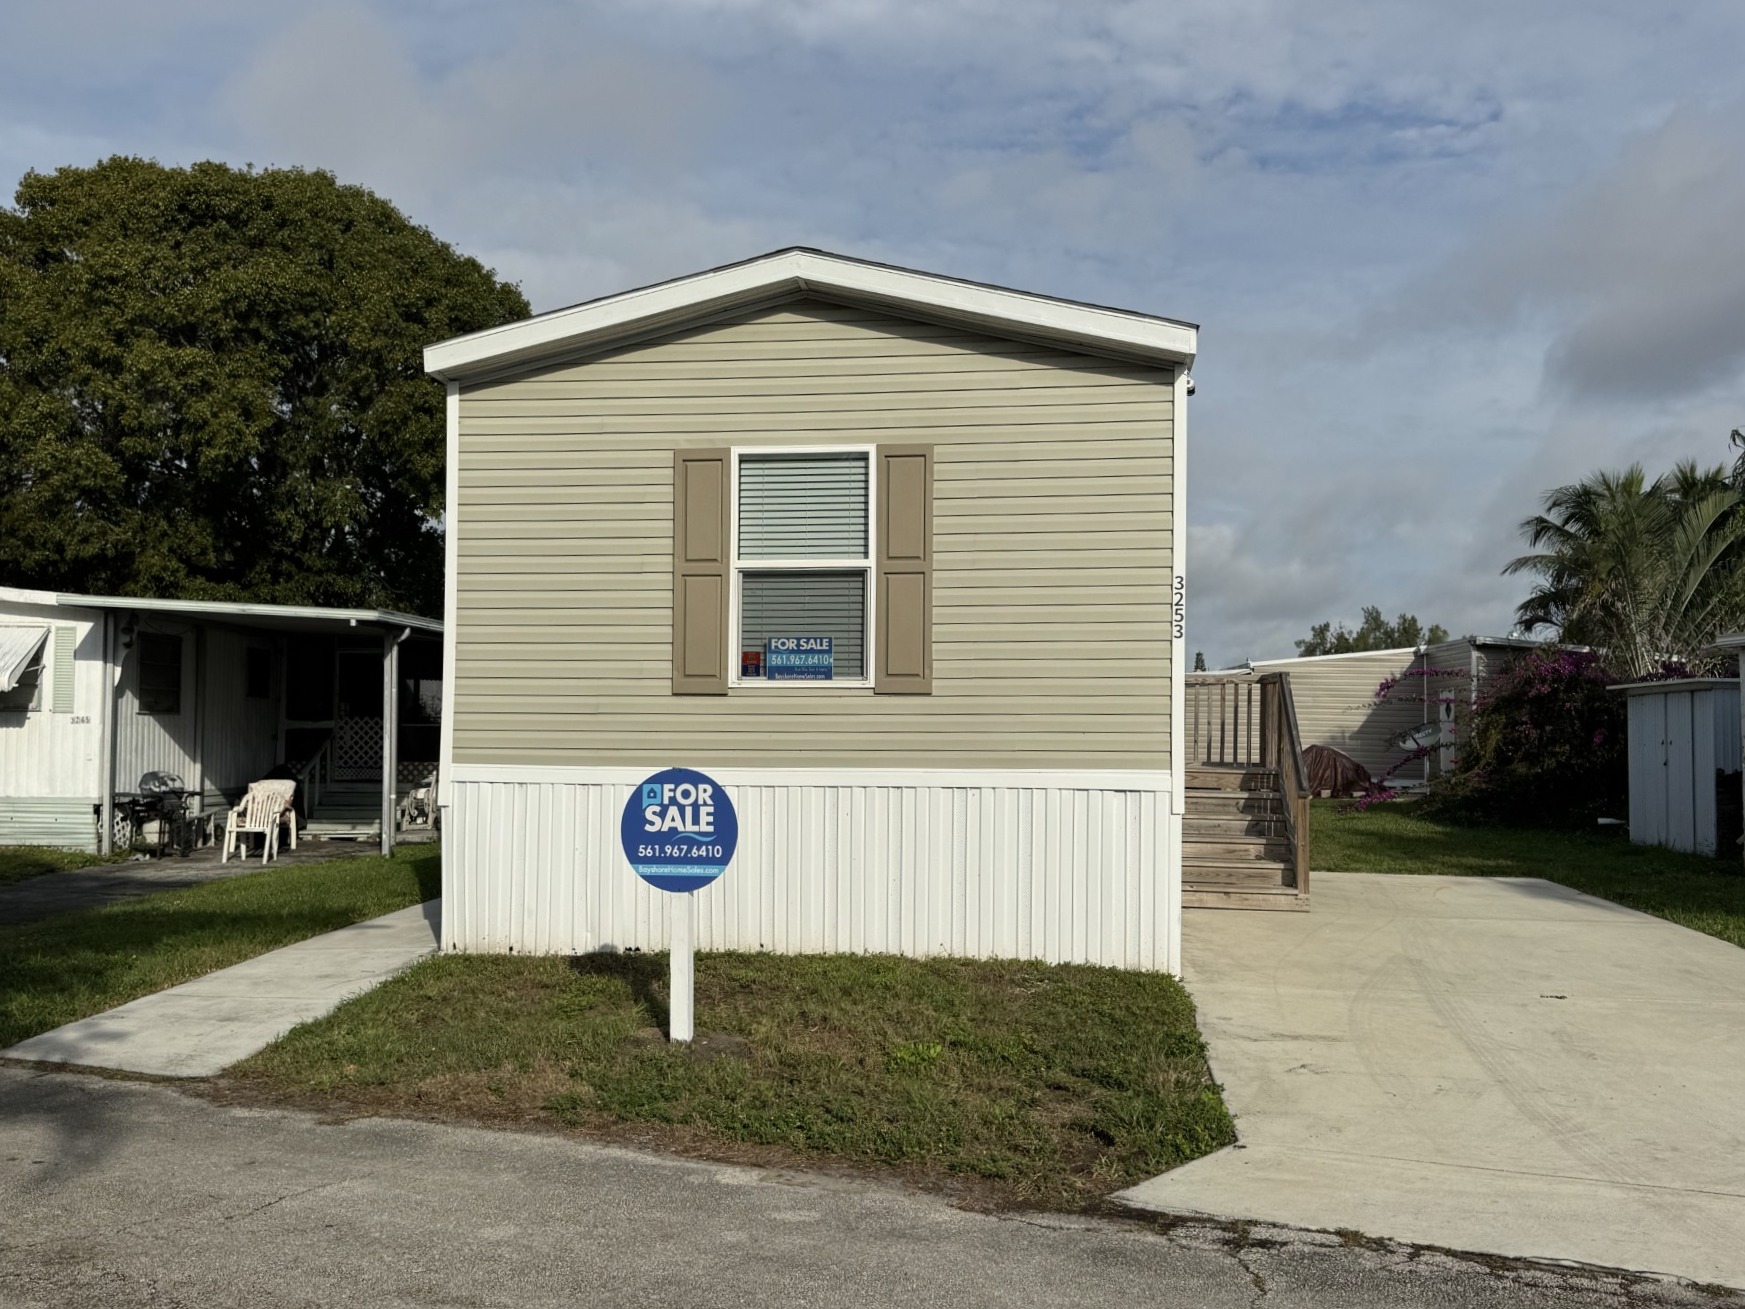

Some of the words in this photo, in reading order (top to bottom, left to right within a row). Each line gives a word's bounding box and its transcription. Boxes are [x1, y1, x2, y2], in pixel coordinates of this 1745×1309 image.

[1173, 575, 1185, 639] 3253
[771, 638, 798, 650] FOR
[799, 638, 829, 650] SALE
[771, 654, 829, 665] 561.967.6410
[662, 783, 714, 805] FOR
[644, 805, 715, 833] SALE
[638, 845, 723, 858] 561.967.6410
[638, 865, 719, 875] BayshoreHomeSales.com
